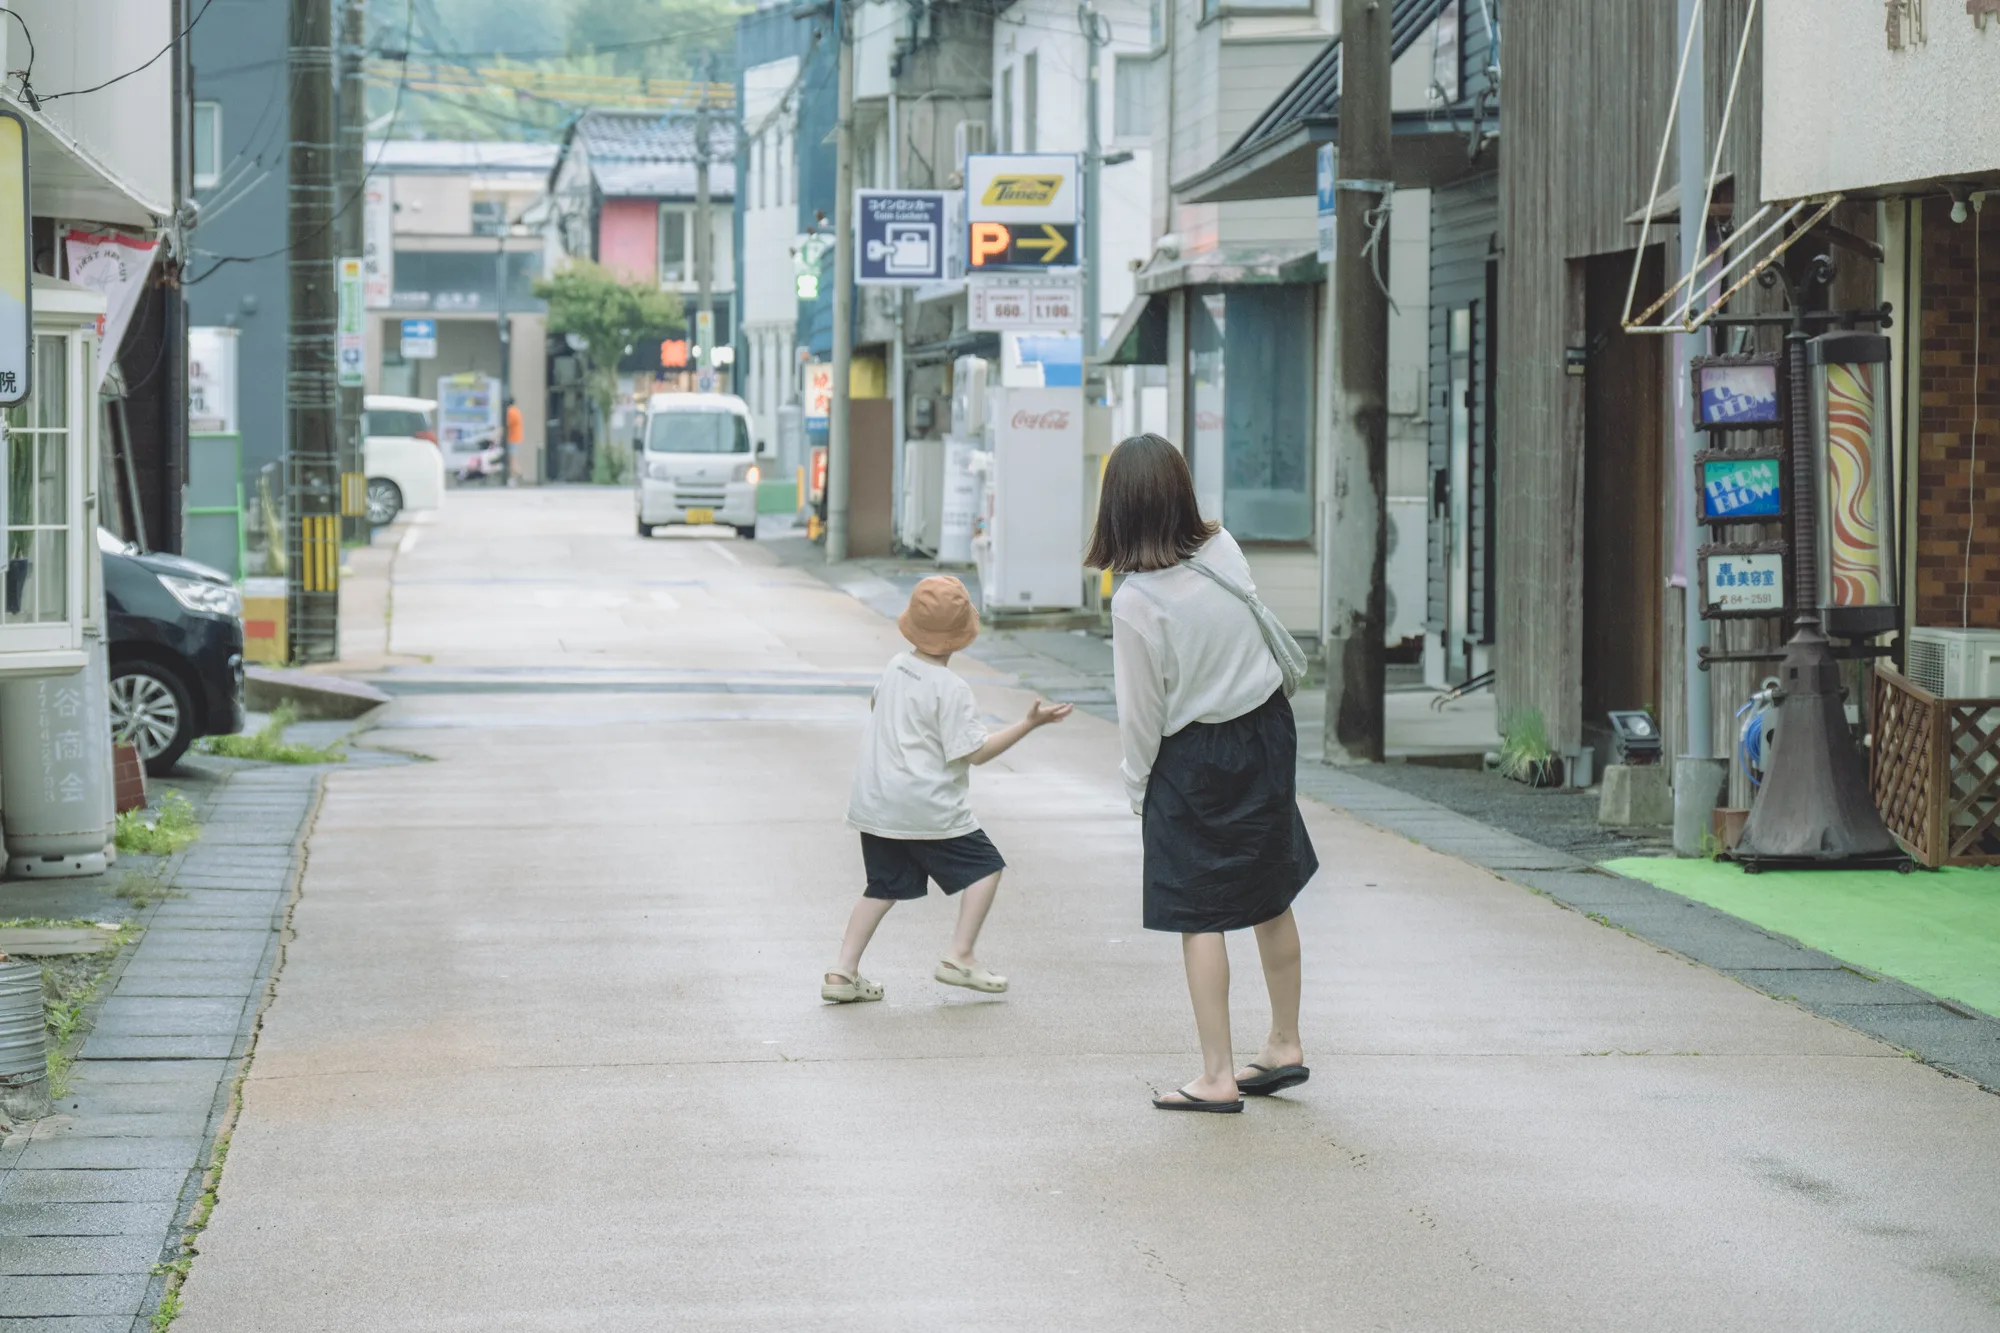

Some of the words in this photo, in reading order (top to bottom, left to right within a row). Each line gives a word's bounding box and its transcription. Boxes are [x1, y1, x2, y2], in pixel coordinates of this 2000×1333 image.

[868, 198, 936, 212] コインロッカー
[994, 180, 1050, 201] Times
[971, 222, 1011, 266] P
[75, 251, 99, 276] FIRST
[1707, 462, 1772, 498] PERM
[1714, 481, 1773, 514] BLOW
[52, 688, 83, 802] 谷商会
